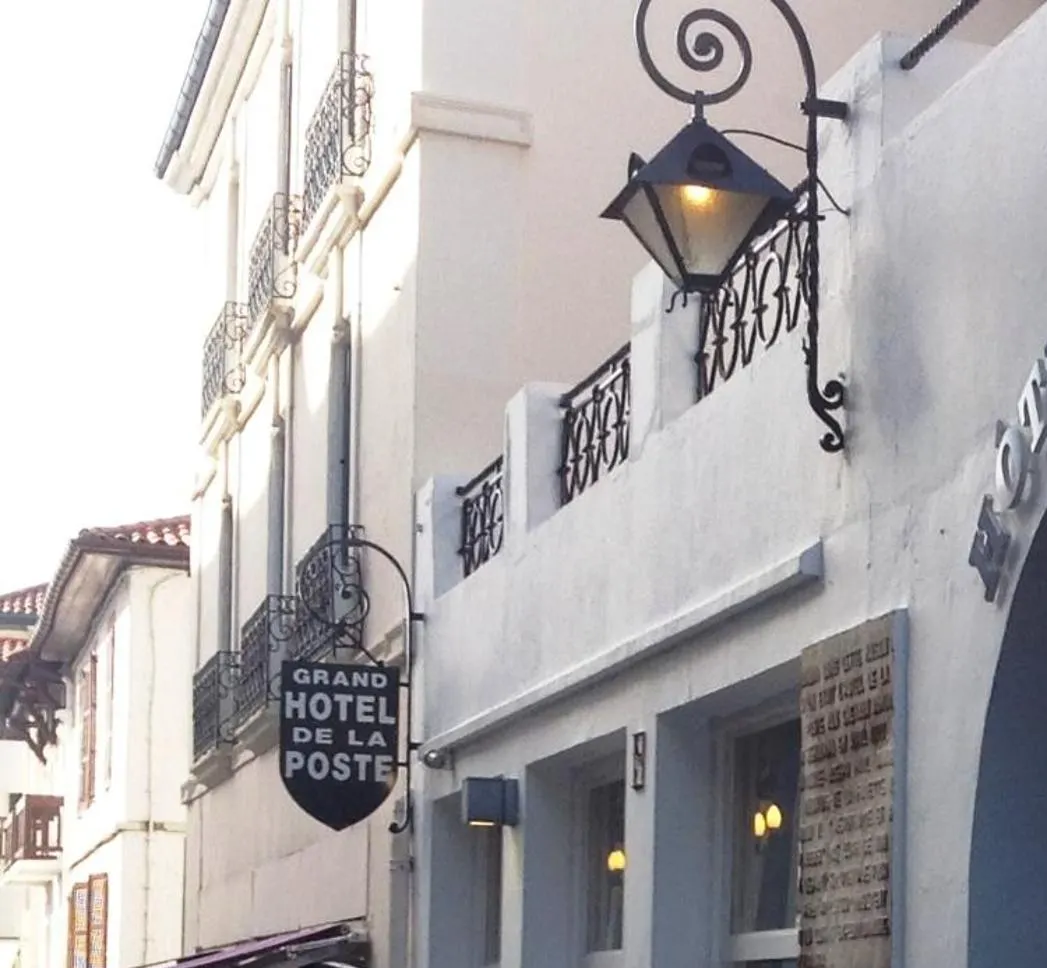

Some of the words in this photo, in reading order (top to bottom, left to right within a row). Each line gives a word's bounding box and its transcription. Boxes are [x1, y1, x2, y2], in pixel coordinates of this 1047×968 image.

[293, 668, 388, 688] GRAND
[285, 691, 396, 725] HOTEL
[292, 727, 333, 745] DE
[348, 729, 387, 747] LA
[285, 750, 395, 783] POSTE
